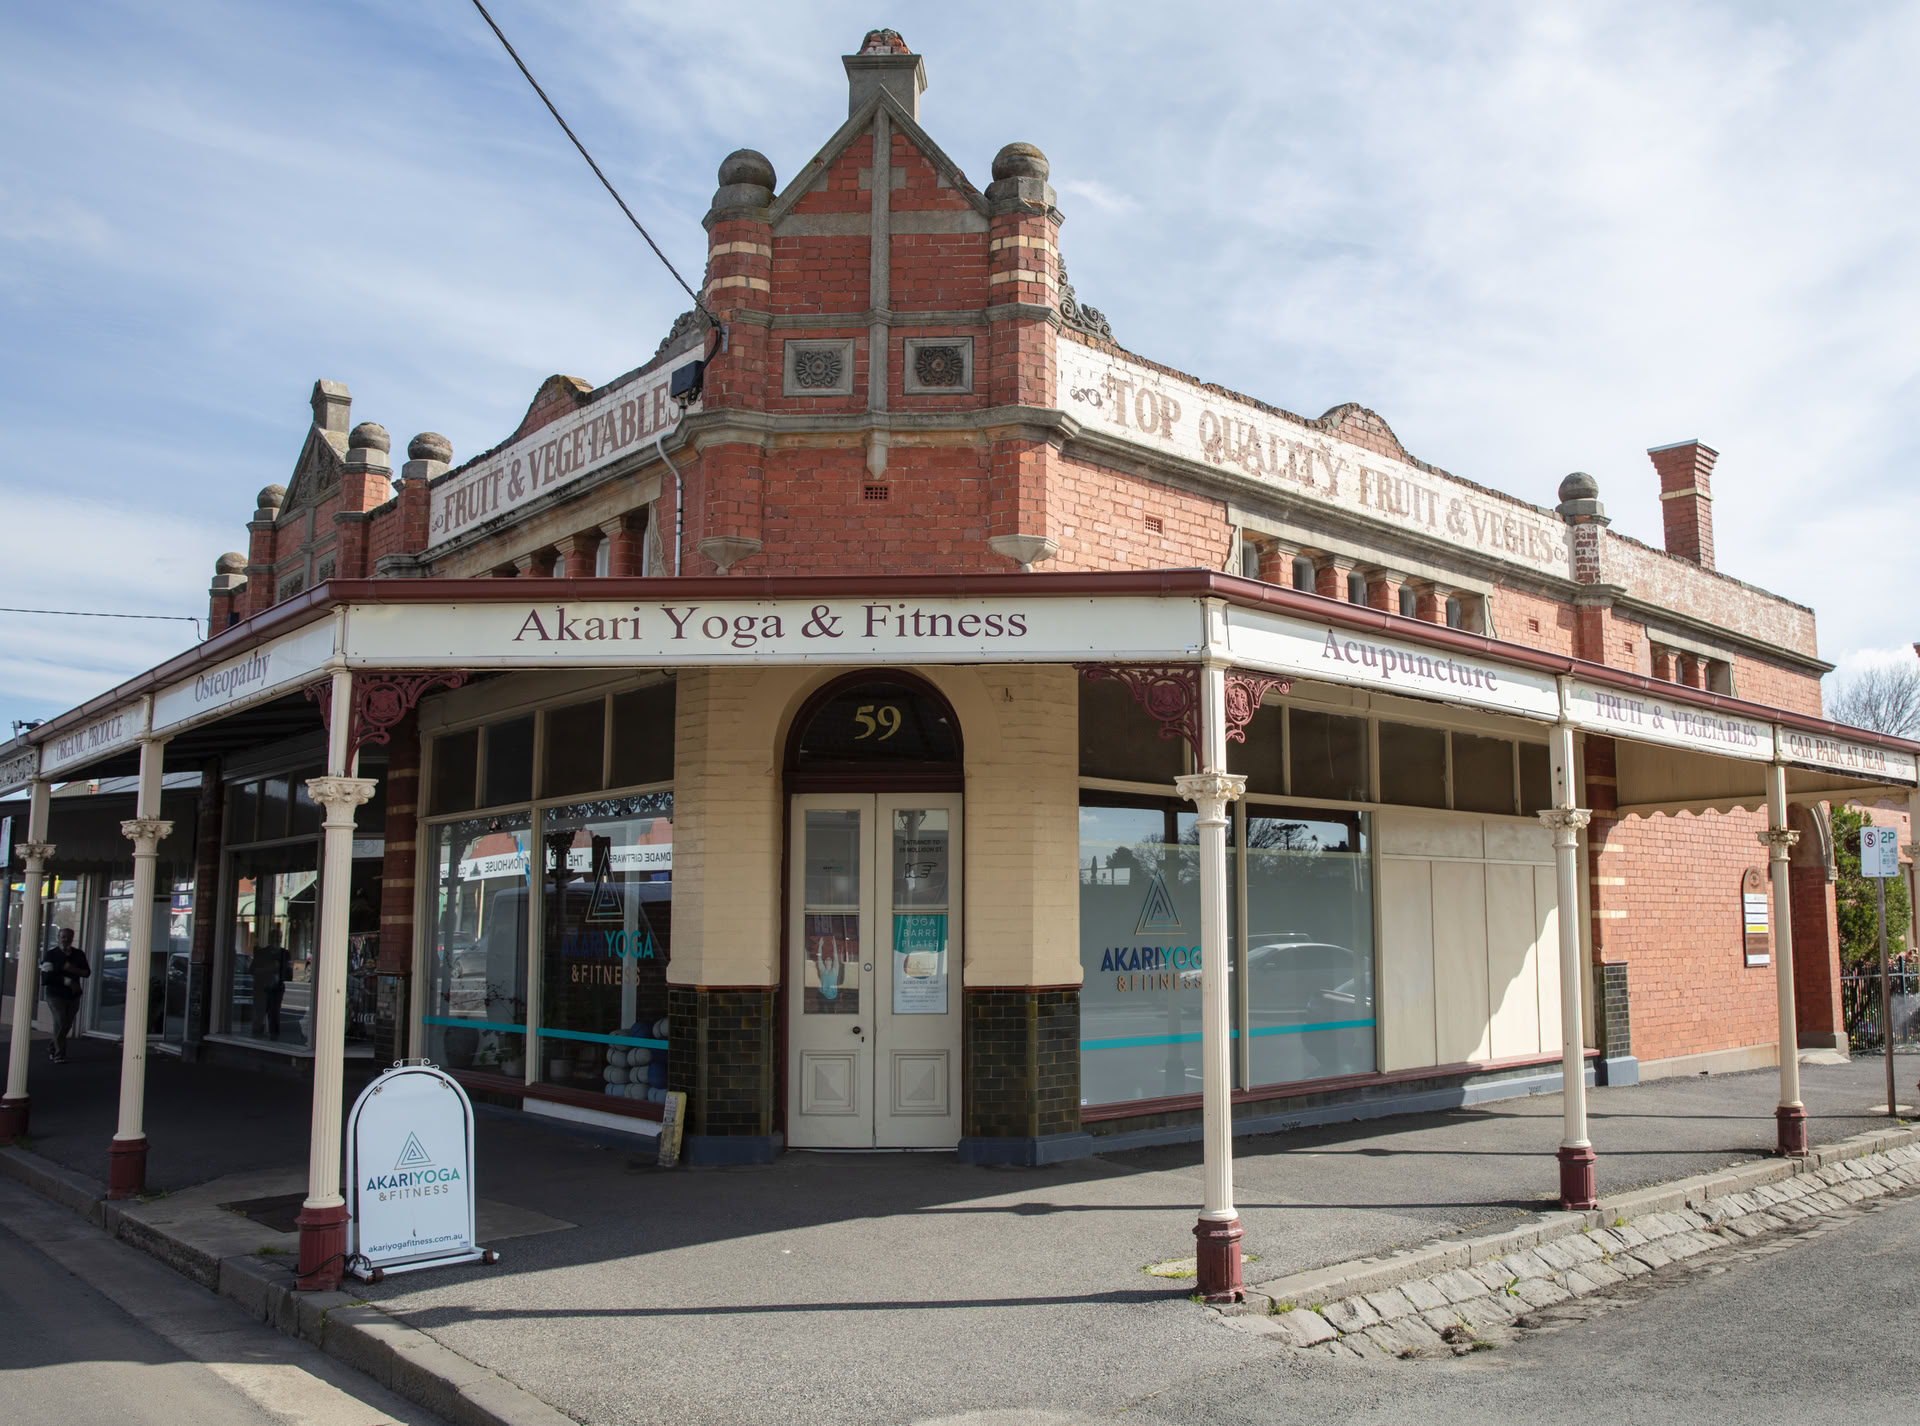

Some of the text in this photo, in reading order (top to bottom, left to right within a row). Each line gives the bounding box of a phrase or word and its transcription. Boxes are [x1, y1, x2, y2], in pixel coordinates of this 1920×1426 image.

[443, 381, 681, 534] FRUIT & VEGETABLES
[1101, 374, 1553, 564] TOP QUALITY FRUIT & VEGIES
[512, 603, 1028, 648] Akari Yoga & Fitness
[195, 650, 271, 702] Osteopathy
[1322, 628, 1498, 692] Acupuncture
[854, 705, 901, 741] 59
[1595, 692, 1758, 748] FRUIT & VEGETABLES
[56, 715, 123, 762] ORGANIC PRODUCE
[1789, 734, 1886, 771] CAR PARK AT REAR
[1880, 832, 1896, 844] 2P
[903, 928, 937, 937] BARRE
[904, 918, 936, 927] YOGA
[901, 940, 939, 948] PILATES
[1100, 945, 1202, 971] AKARIYOG
[366, 1167, 461, 1192] AKARIYOGA
[368, 1233, 463, 1253] akariyogafitness.com.au
